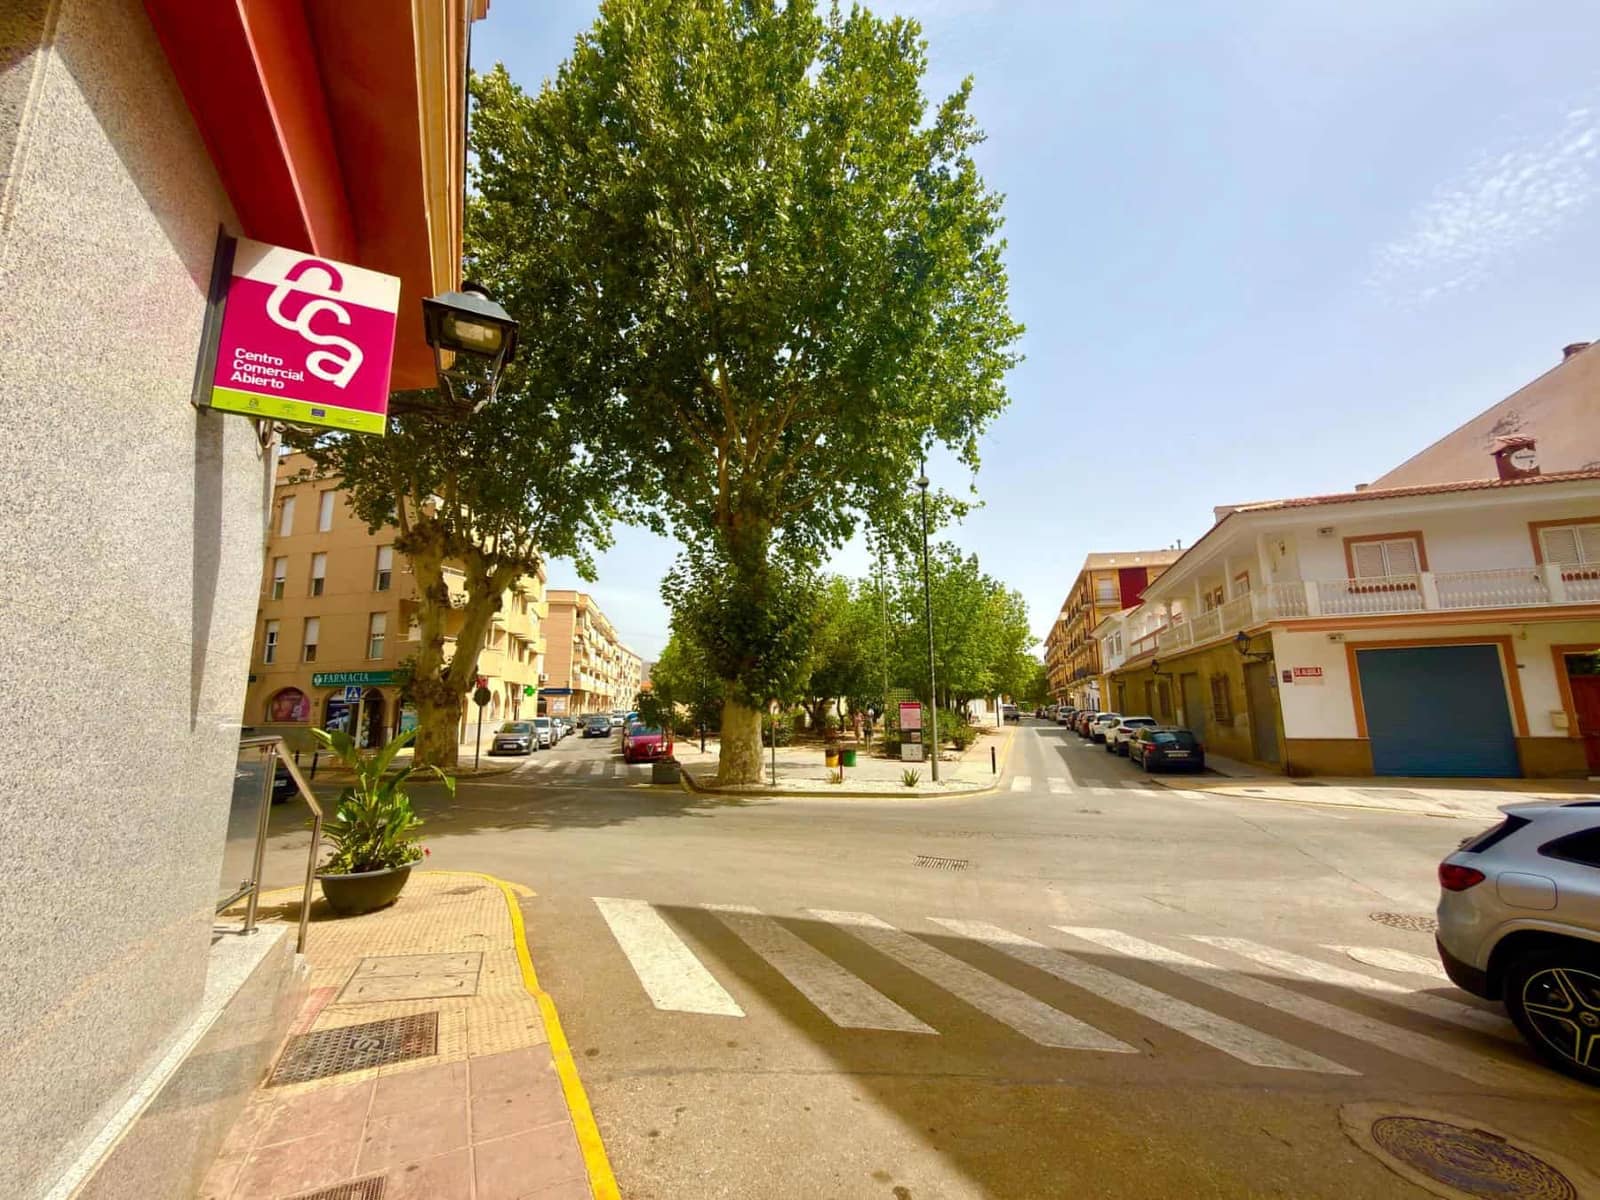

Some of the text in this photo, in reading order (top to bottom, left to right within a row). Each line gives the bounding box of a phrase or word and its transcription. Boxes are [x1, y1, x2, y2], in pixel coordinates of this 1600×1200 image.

[235, 347, 283, 366] Centro
[233, 359, 304, 382] Comercial
[230, 371, 285, 390] Abierto
[323, 673, 369, 683] FARMACIA
